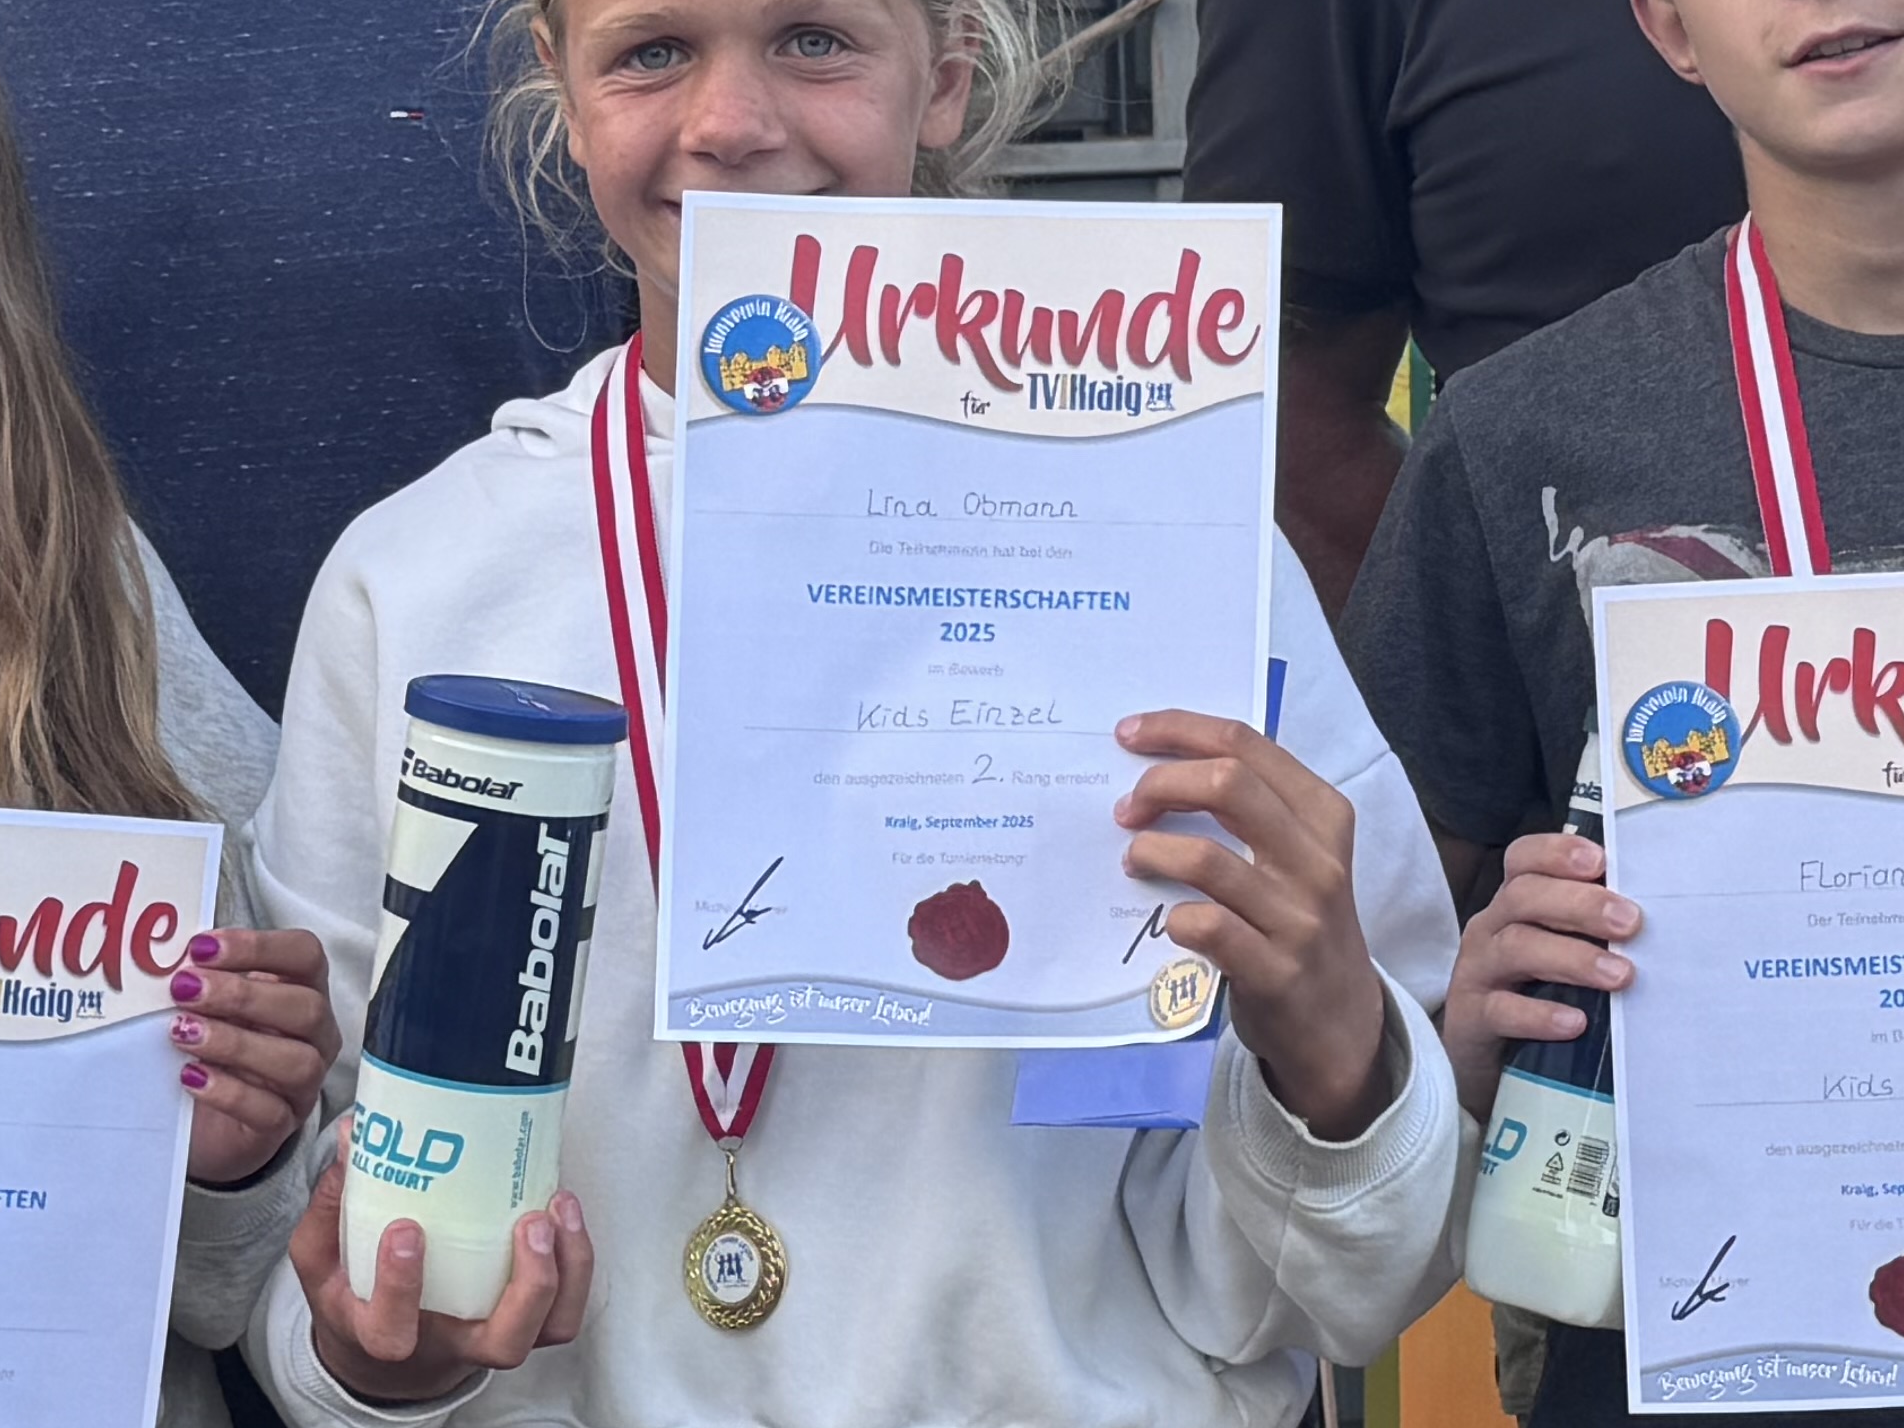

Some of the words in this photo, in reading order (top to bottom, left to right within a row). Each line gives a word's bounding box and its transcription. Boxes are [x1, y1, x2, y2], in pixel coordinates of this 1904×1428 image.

[790, 234, 1260, 392] Urkunde
[867, 488, 938, 518] Lina
[963, 492, 1079, 518] Obmann
[806, 583, 1131, 611] VEREINSMEISTERSCHAFTEN
[939, 621, 996, 643] 2025
[971, 753, 1005, 785] 2.
[351, 1101, 465, 1175] GOLD
[373, 1162, 434, 1192] COURT
